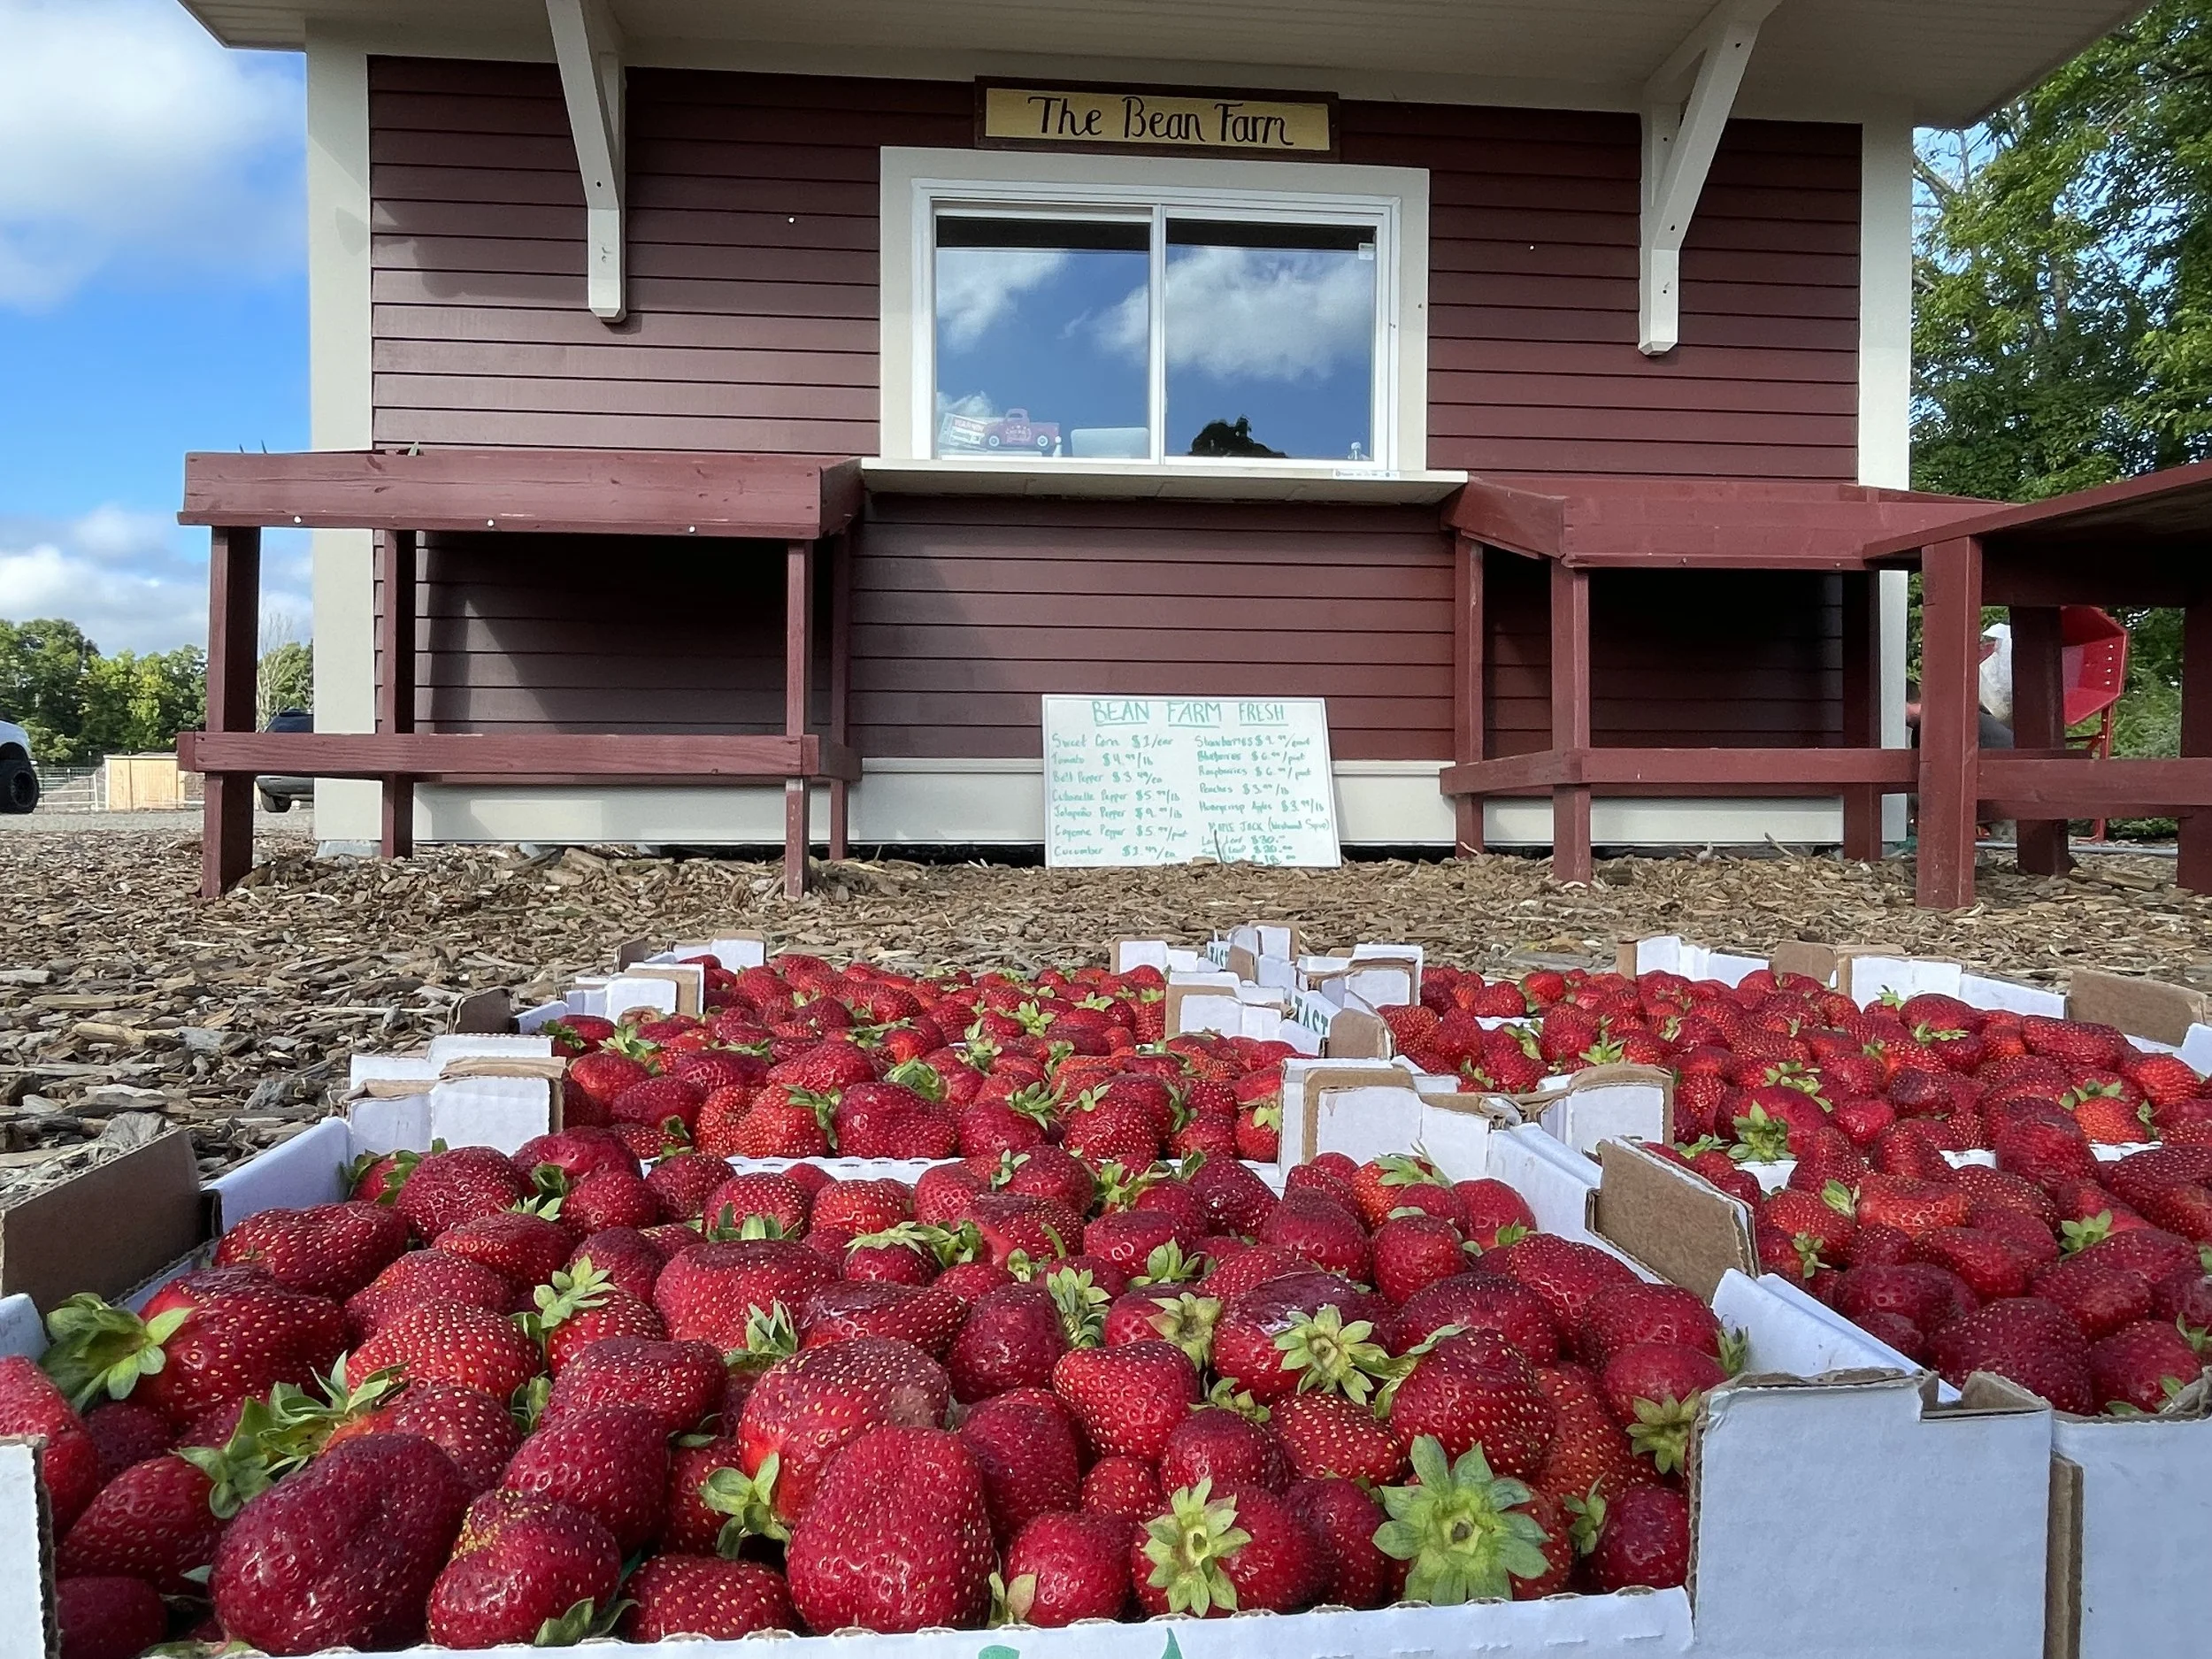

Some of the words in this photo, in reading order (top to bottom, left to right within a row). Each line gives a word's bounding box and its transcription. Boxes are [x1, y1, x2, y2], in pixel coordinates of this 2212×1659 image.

[1027, 96, 1103, 136] The
[1122, 96, 1206, 142] Bean
[1214, 102, 1294, 146] Farm
[1092, 701, 1149, 723] BEAN
[1166, 701, 1222, 723] FARM
[1239, 703, 1286, 723] FRESH
[1052, 733, 1087, 748] Sweet
[1095, 733, 1120, 748] Corn
[1051, 752, 1085, 764] Tomato
[1052, 771, 1073, 783] Bell
[1078, 771, 1103, 784] Pepper
[1198, 765, 1248, 779] Raspberries
[1199, 782, 1233, 794] Peaches
[1101, 788, 1128, 803] Pepper
[1100, 806, 1126, 819] Pepper
[1252, 800, 1272, 814] Apples
[1055, 824, 1092, 841] Cayenne
[1100, 824, 1126, 840] Pepper
[1239, 821, 1264, 832] JACK
[1054, 845, 1103, 856] Cucumber
[1294, 995, 1328, 1035] TAST
